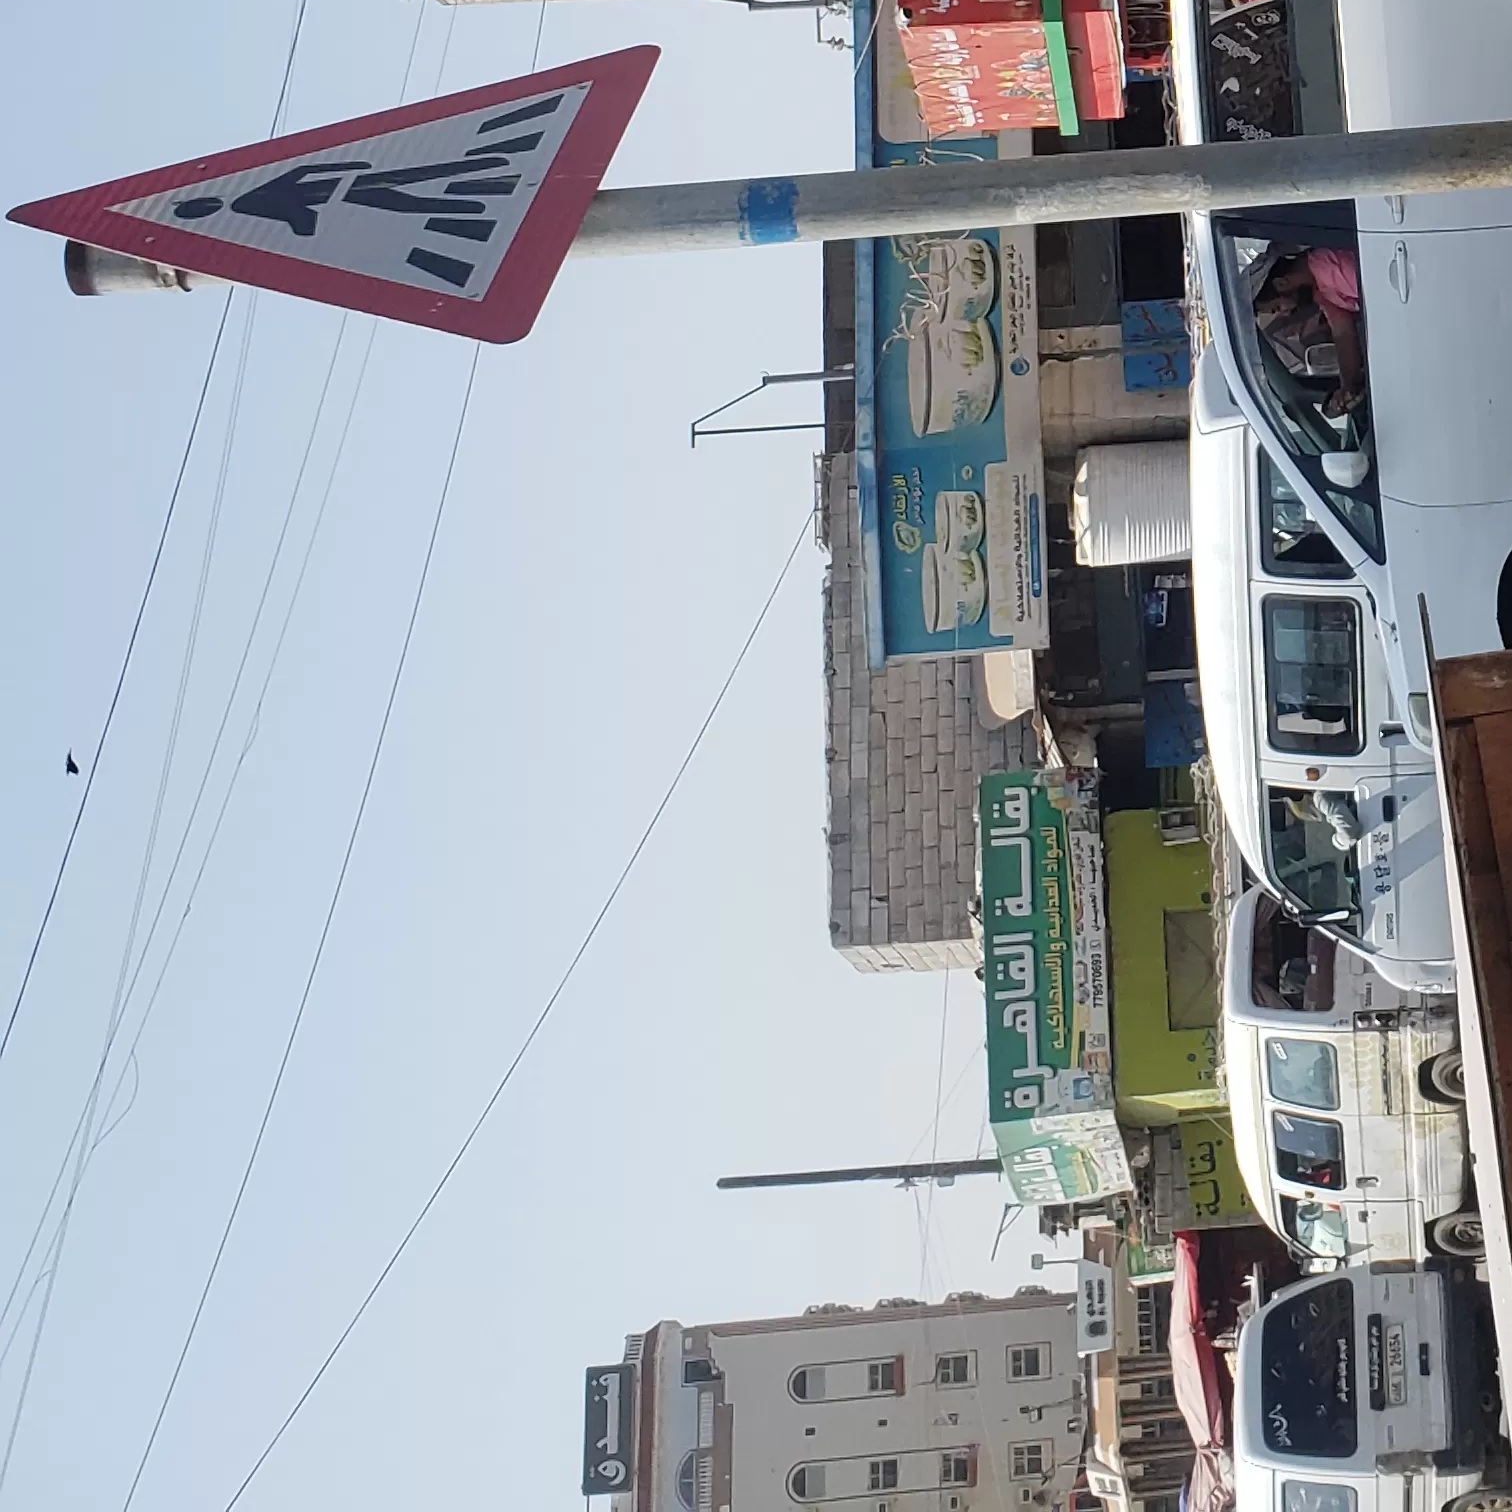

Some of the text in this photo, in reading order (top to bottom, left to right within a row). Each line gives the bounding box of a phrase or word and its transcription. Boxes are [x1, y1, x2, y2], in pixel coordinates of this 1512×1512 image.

[1039, 827, 1064, 872] للمواد
[988, 785, 1055, 1109] بقالة القاهرة
[1188, 1139, 1223, 1216] بقالة
[589, 1373, 627, 1486] فندق
